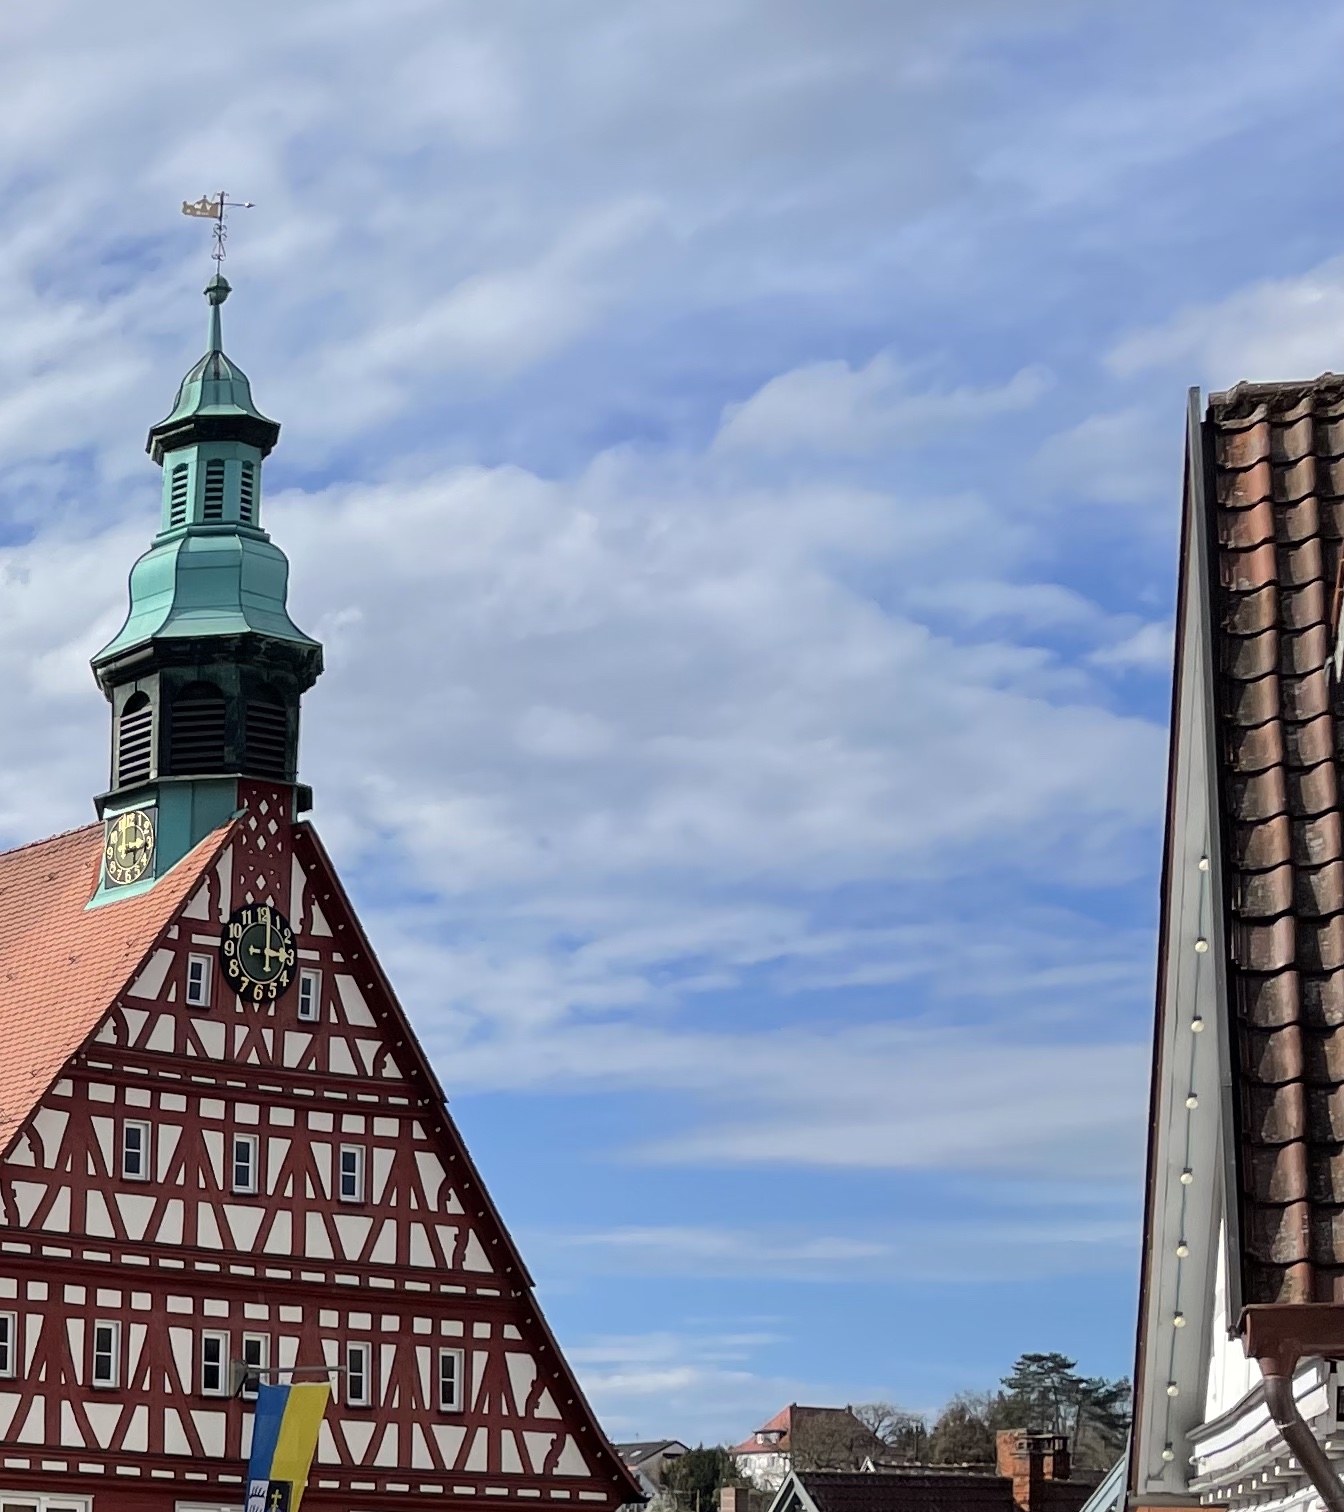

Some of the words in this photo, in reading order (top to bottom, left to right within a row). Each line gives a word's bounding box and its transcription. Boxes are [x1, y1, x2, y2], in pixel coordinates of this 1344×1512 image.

[138, 814, 142, 826] 1
[143, 821, 150, 834] 2
[107, 846, 114, 860] 9
[109, 861, 116, 874] 8
[116, 868, 122, 880] 7
[124, 869, 132, 882] 6
[241, 910, 252, 925] 11
[257, 907, 270, 923] 12
[275, 915, 281, 930] 1
[228, 923, 242, 938] 10
[283, 928, 292, 945] 2
[224, 940, 235, 956] 9
[286, 949, 295, 966] 3
[228, 959, 239, 978] 8
[239, 976, 249, 992] 7
[279, 970, 290, 987] 4
[253, 984, 264, 1000] 6
[267, 982, 277, 999] 5
